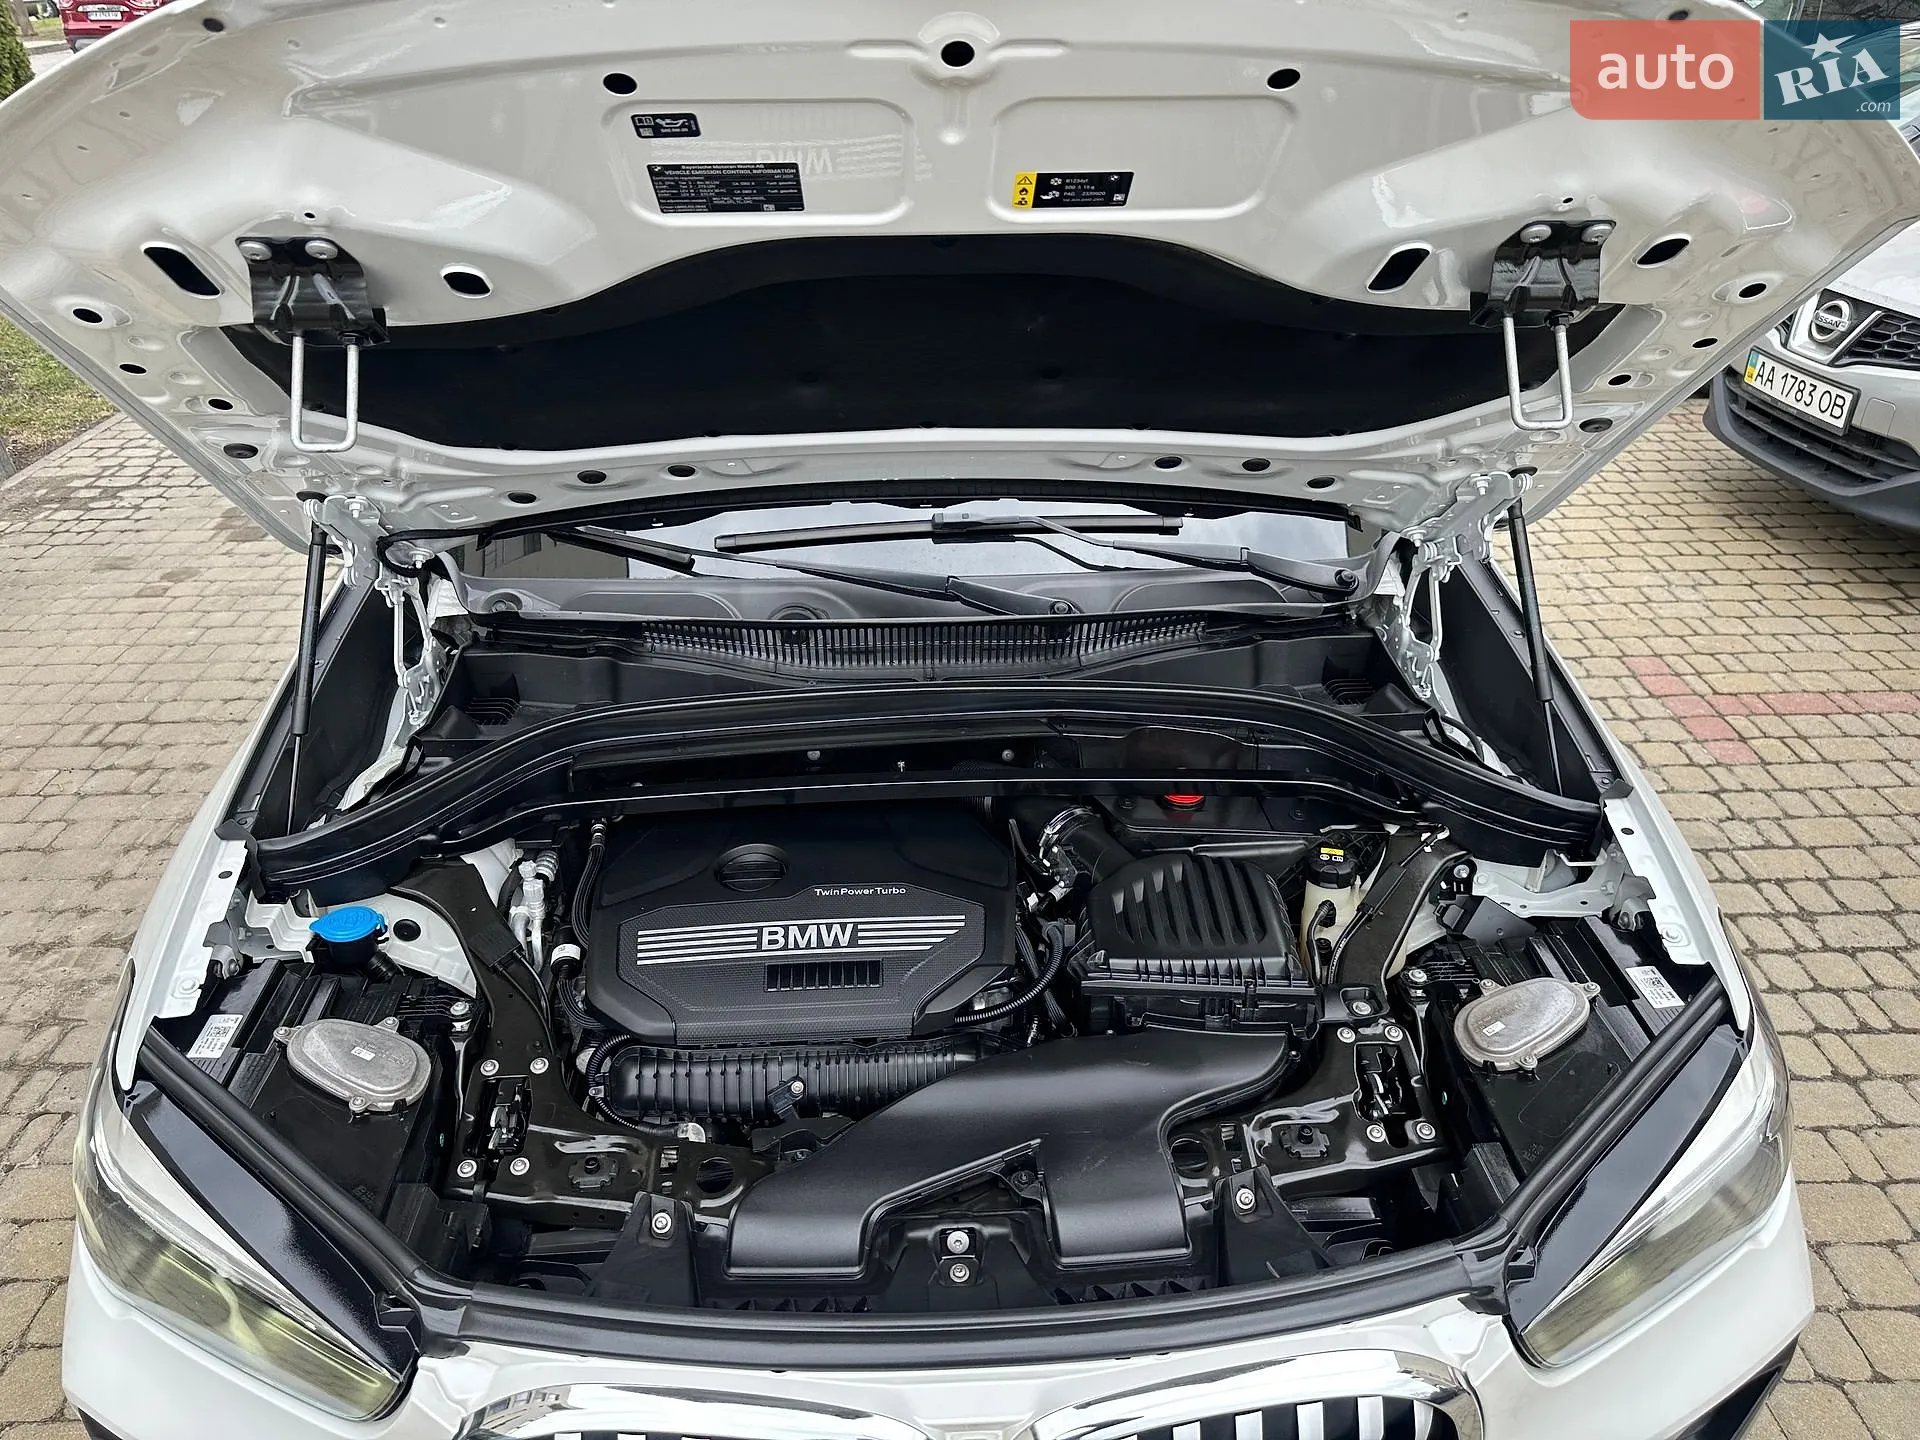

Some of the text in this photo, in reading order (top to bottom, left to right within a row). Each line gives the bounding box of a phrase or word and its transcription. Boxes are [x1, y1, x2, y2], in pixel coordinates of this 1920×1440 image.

[1754, 361, 1846, 419] AA 1783 OB
[761, 923, 854, 950] BMW
